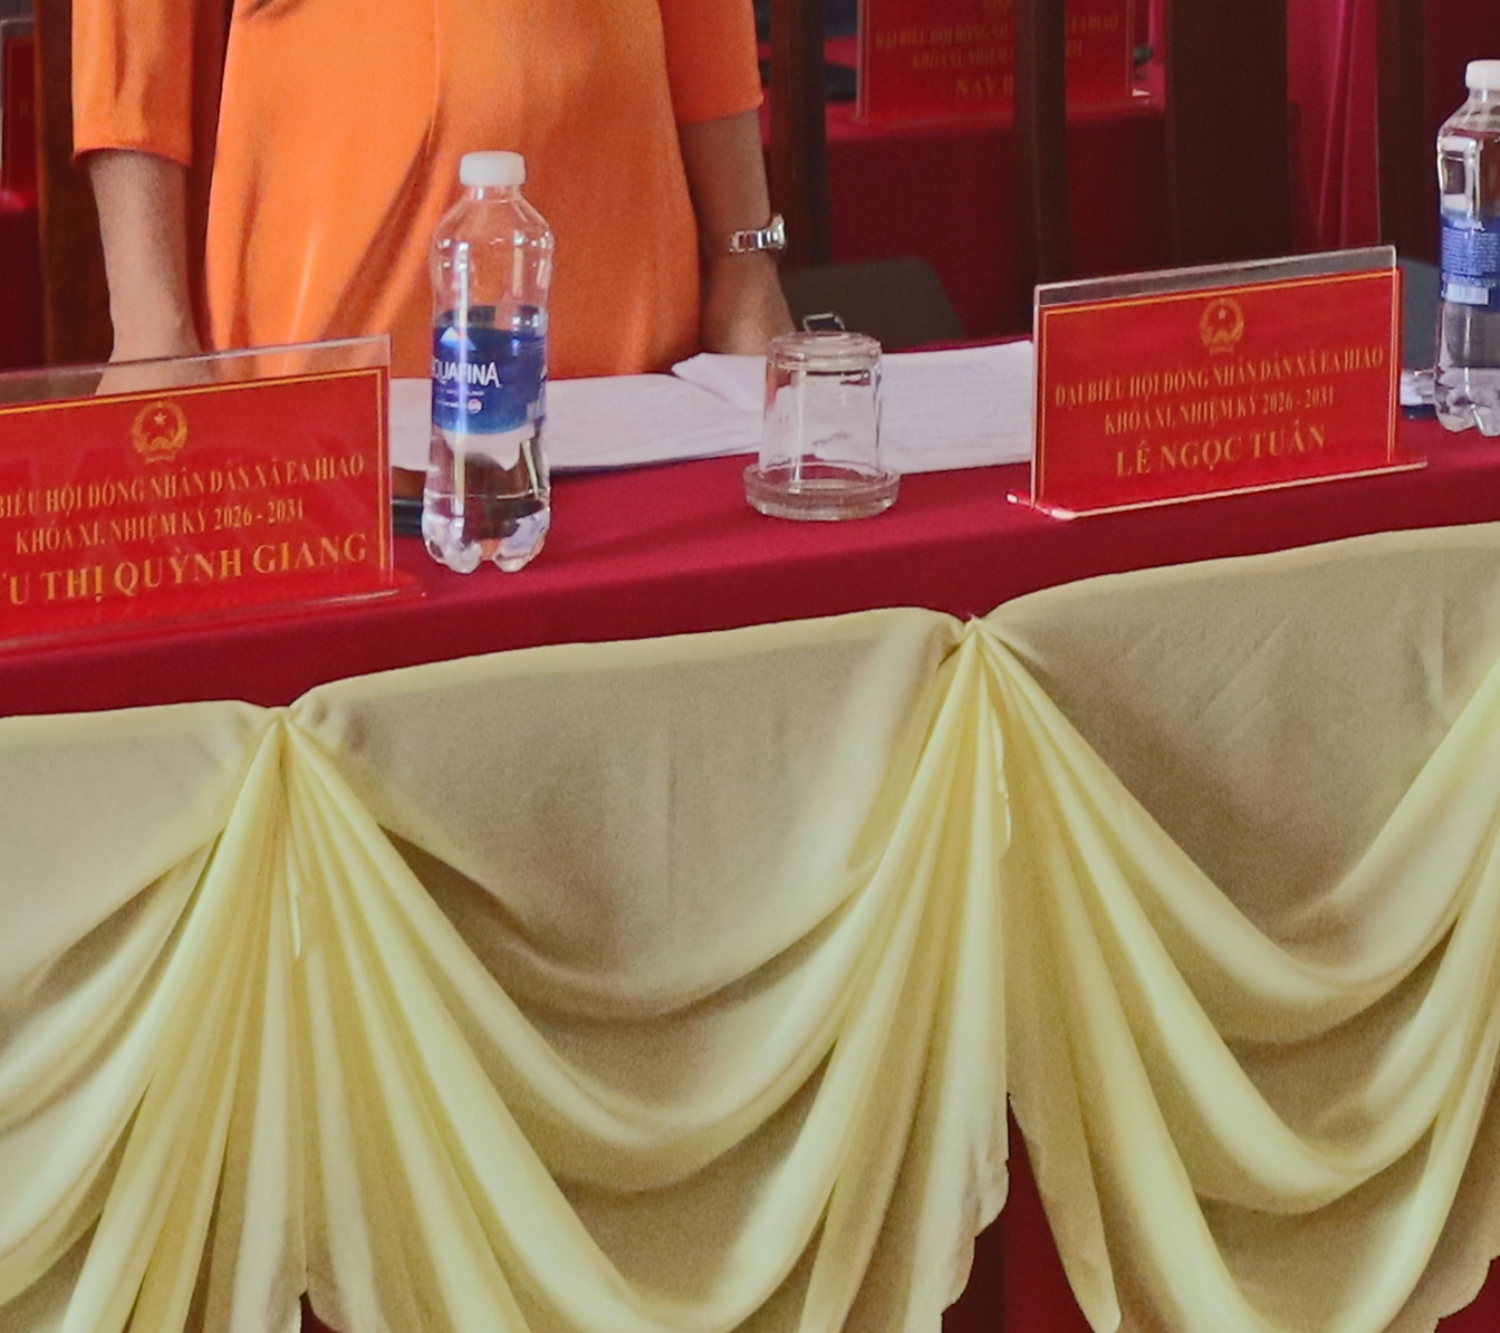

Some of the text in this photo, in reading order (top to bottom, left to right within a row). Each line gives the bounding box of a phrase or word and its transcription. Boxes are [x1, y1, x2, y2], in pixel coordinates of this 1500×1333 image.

[1343, 345, 1384, 371] HIAO
[1262, 391, 1294, 415] 2026
[1304, 385, 1334, 410] 2031
[1116, 437, 1152, 477] LÊ
[1159, 434, 1243, 473] NGỌC
[45, 480, 83, 518] HỘI
[87, 473, 146, 509] ĐỒNG
[150, 464, 205, 500] NHÂN
[209, 458, 250, 495] DÂN
[254, 454, 281, 489] XÃ
[286, 460, 311, 485] EA
[314, 453, 365, 482] HIAO
[15, 515, 75, 555] KHÓA
[109, 511, 178, 545] NHIỆM
[213, 504, 253, 532] 2026
[267, 496, 304, 525] 2031
[39, 564, 104, 604] THỊ
[113, 545, 243, 598] QUỲNH
[252, 532, 367, 575] GIANG
